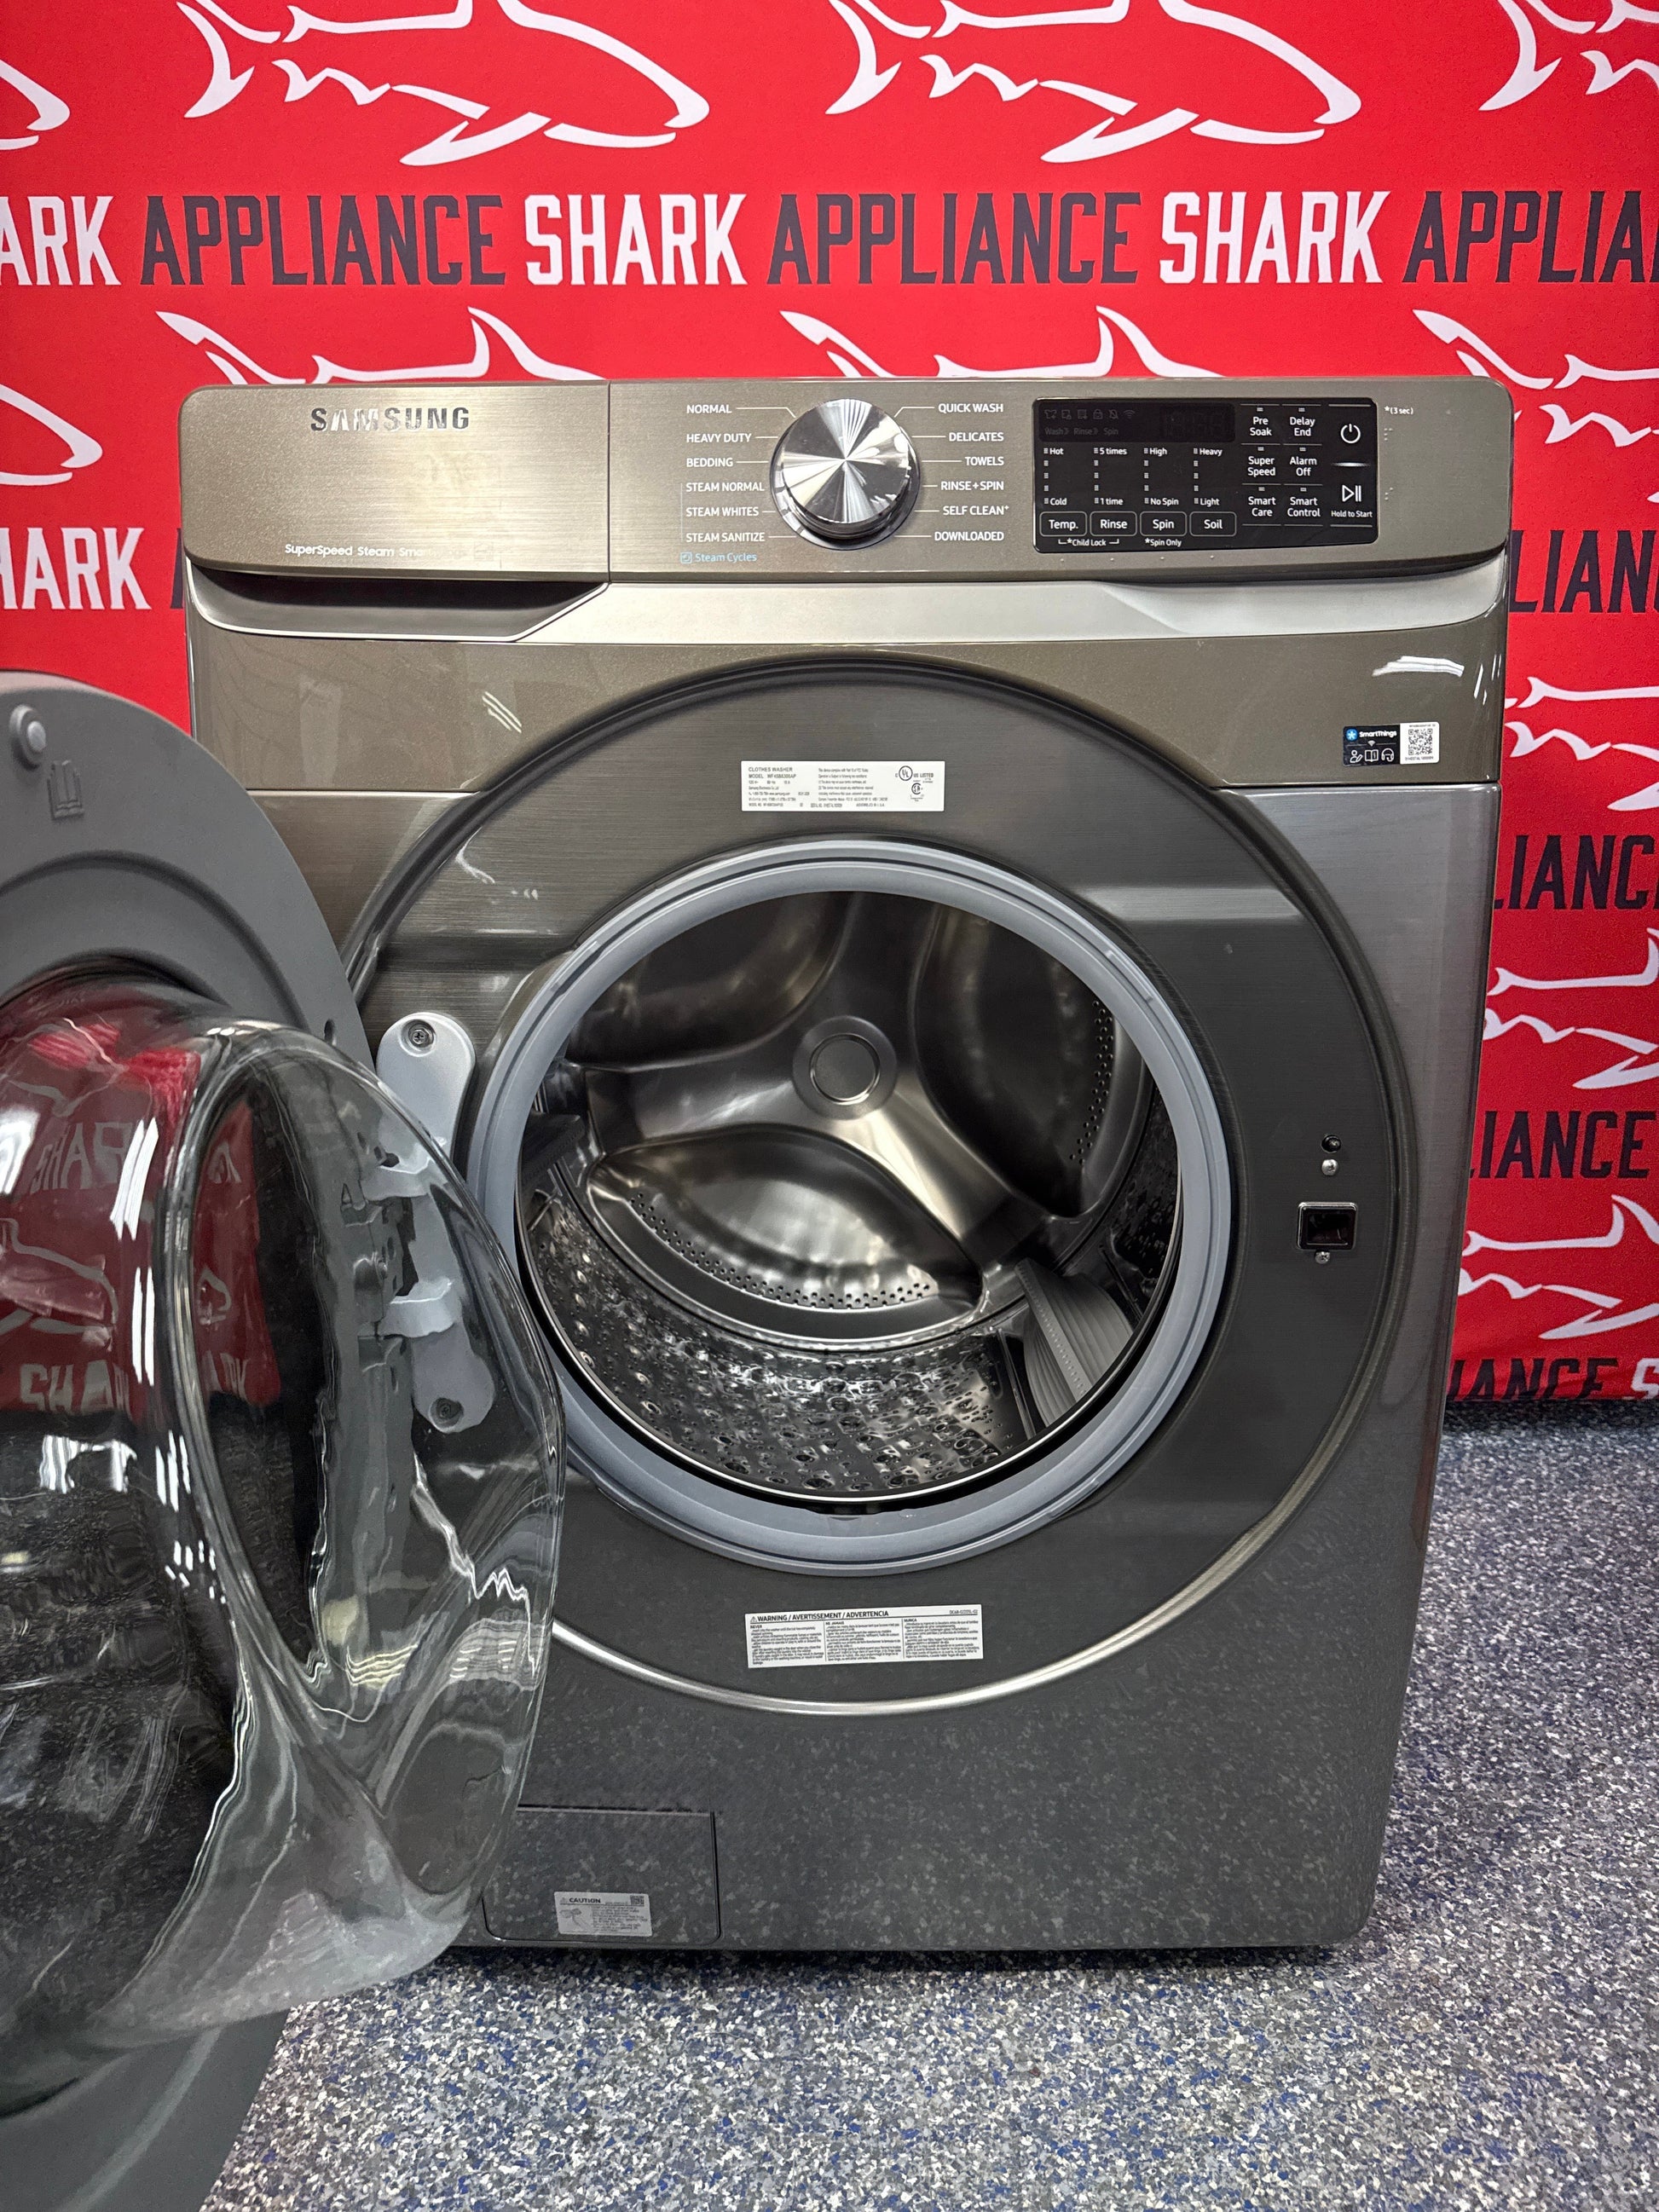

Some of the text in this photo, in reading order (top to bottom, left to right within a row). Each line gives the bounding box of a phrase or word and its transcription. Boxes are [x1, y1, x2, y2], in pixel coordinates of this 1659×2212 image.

[140, 195, 506, 286] APPLIANCE
[524, 193, 748, 286] SHARK
[767, 193, 1142, 285] APPLIANCE
[1159, 191, 1391, 283] SHARK
[1402, 190, 1659, 283] APPLIA
[686, 404, 732, 414] NORMAL
[938, 403, 1003, 414] QUICK WASH
[311, 407, 469, 431] SAMSUNG
[1253, 417, 1269, 426] Pre
[1290, 417, 1315, 428] Delay
[1251, 427, 1272, 436] Soak
[1295, 427, 1311, 436] End
[686, 433, 752, 443] HEAVY DUTY
[949, 432, 1004, 442] DELICATES
[1150, 448, 1167, 458] High
[1199, 448, 1223, 458] Heavy
[686, 457, 733, 467] BEDDING
[965, 457, 1004, 466] TOWELS
[1249, 457, 1275, 468] Super
[1290, 457, 1317, 465] Alarm
[1247, 466, 1276, 478] Speed
[1296, 466, 1311, 476] Off
[686, 482, 766, 492] STEAM NORMAL
[1161, 498, 1179, 507] Spin
[1200, 498, 1220, 508] Light
[1248, 496, 1276, 505] Smart
[1290, 496, 1317, 505] Smart
[686, 507, 760, 517] STEAM WHITES
[943, 505, 968, 516] SELF
[1251, 507, 1273, 517] Care
[1287, 507, 1321, 517] Control
[1049, 520, 1078, 531] Temp.
[1101, 519, 1128, 529] Rinse
[1153, 519, 1175, 531] Spin
[1204, 519, 1223, 529] Soil
[686, 533, 766, 542] STEAM SANITIZE
[934, 532, 1004, 541] DOWNLOADED
[1090, 538, 1106, 546] Lock
[1165, 538, 1182, 548] Only
[285, 544, 353, 557] SuperSpeed
[357, 546, 395, 557] Steam
[695, 552, 757, 563] Steam Cycles
[1509, 529, 1659, 613] LIAN
[1494, 835, 1659, 910] IANC
[1471, 1111, 1656, 1178] IANCE
[792, 1612, 841, 1620] AVERTISSEMENT
